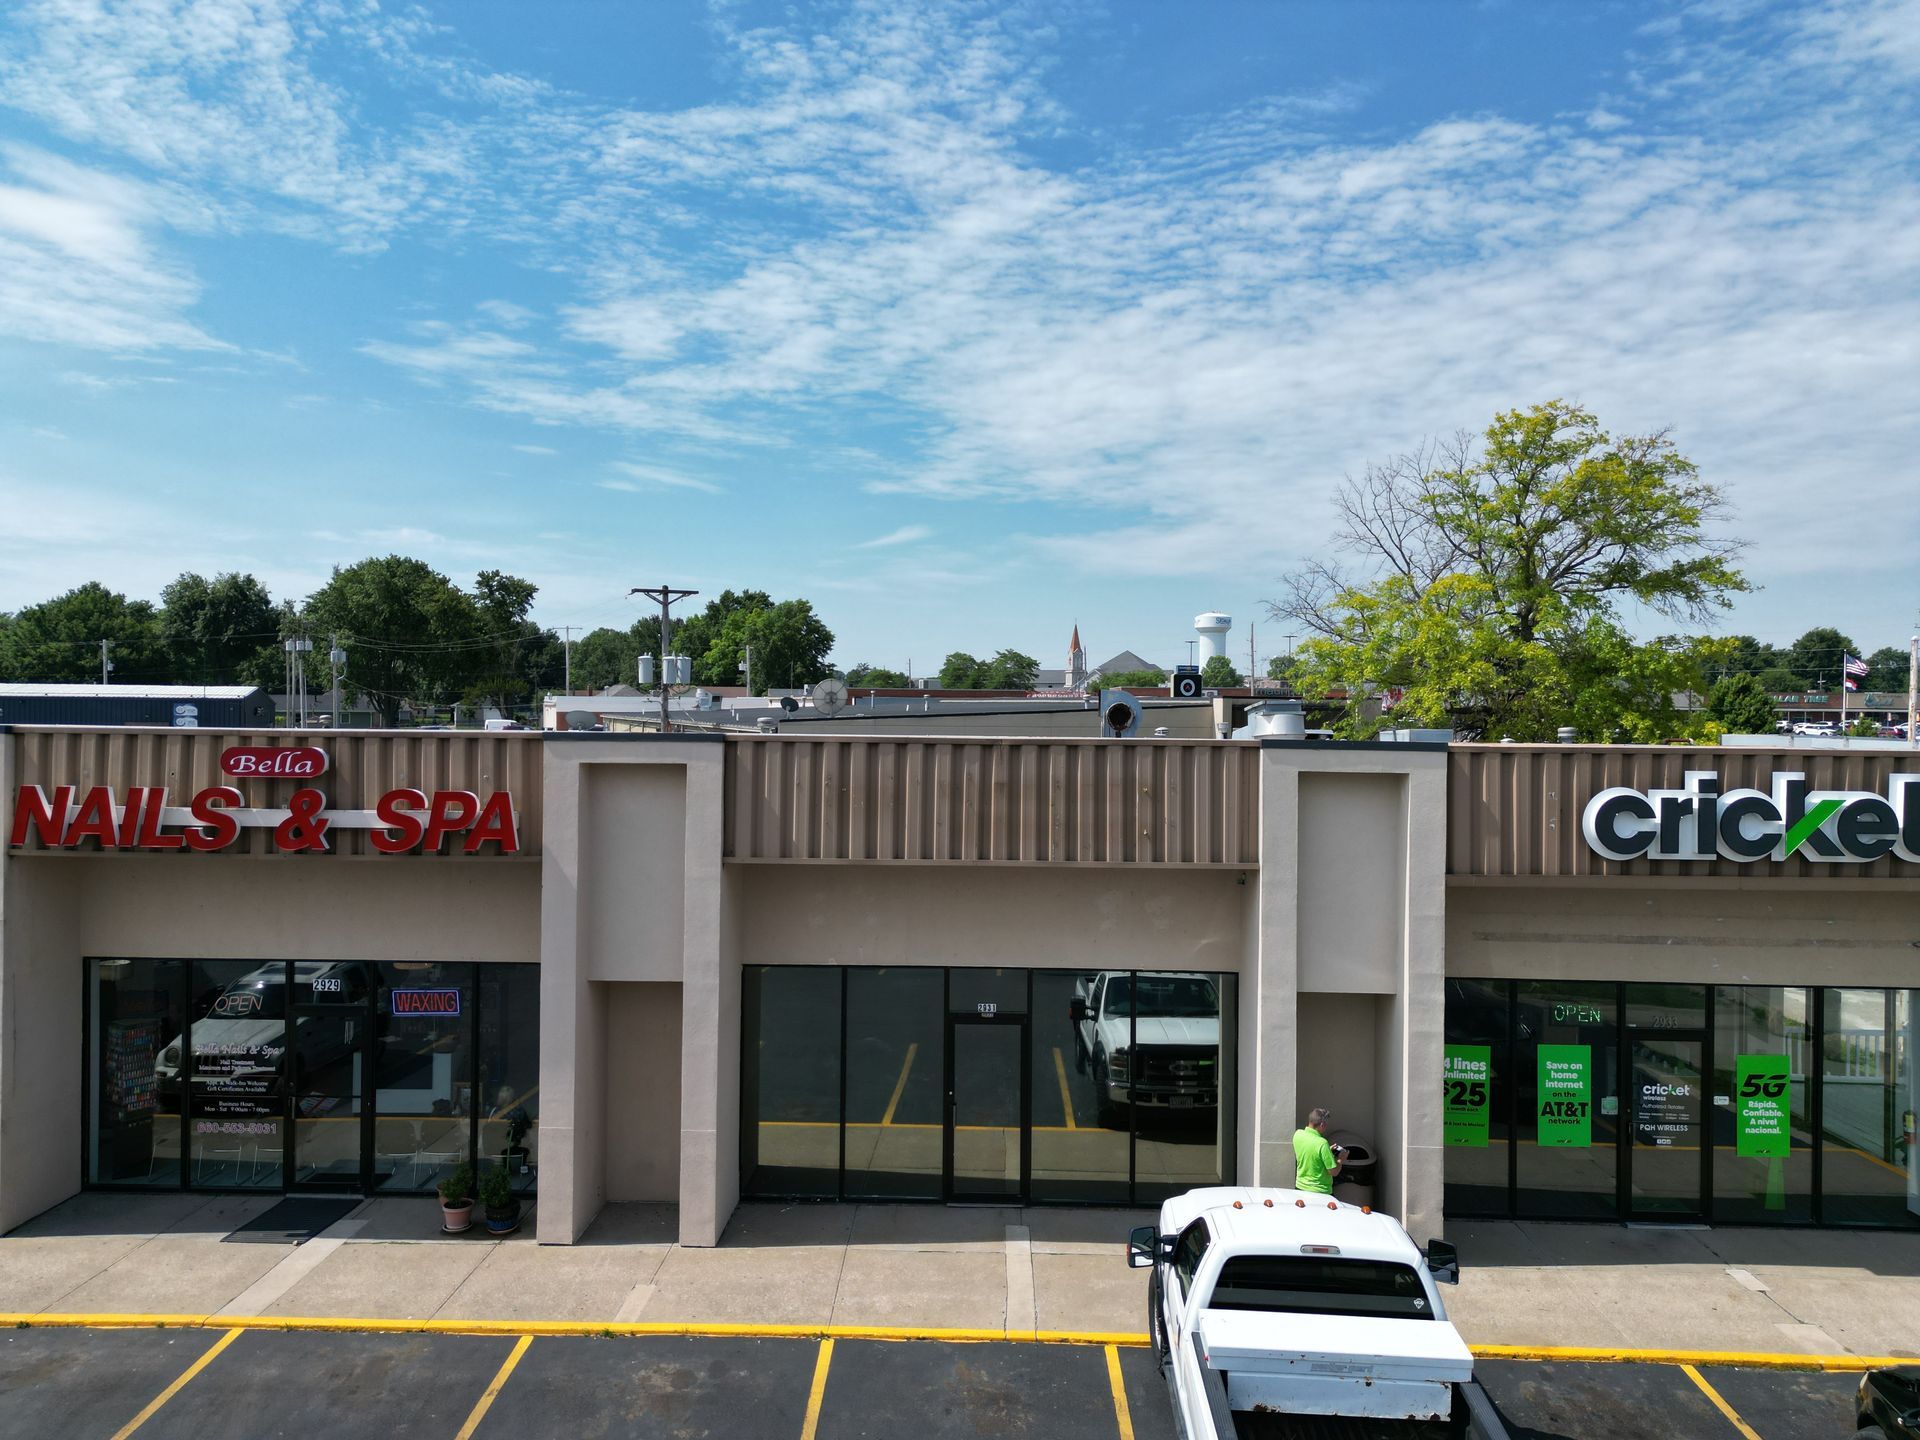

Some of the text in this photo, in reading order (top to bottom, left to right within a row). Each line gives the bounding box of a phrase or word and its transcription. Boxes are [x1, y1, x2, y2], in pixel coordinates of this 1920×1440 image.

[230, 752, 314, 774] Bella
[10, 784, 520, 852] NAILS & SPA
[313, 980, 340, 991] 2929
[214, 995, 263, 1012] OPEN
[395, 993, 456, 1012] WAXING
[978, 1004, 996, 1012] 2931
[1554, 1004, 1601, 1022] OPEN
[1652, 1016, 1679, 1028] 2933
[261, 1045, 281, 1059] Spa
[1454, 1058, 1487, 1071] lines
[1546, 1061, 1583, 1070] Save on
[1551, 1071, 1578, 1079] home
[1546, 1080, 1583, 1089] internet
[1643, 1084, 1690, 1096] cricket
[1740, 1074, 1788, 1098] 5G
[1541, 1101, 1588, 1118] AT&T
[1748, 1101, 1778, 1109] Rápida.
[1743, 1109, 1784, 1117] Confiable.
[1657, 1124, 1688, 1132] WIRELESS
